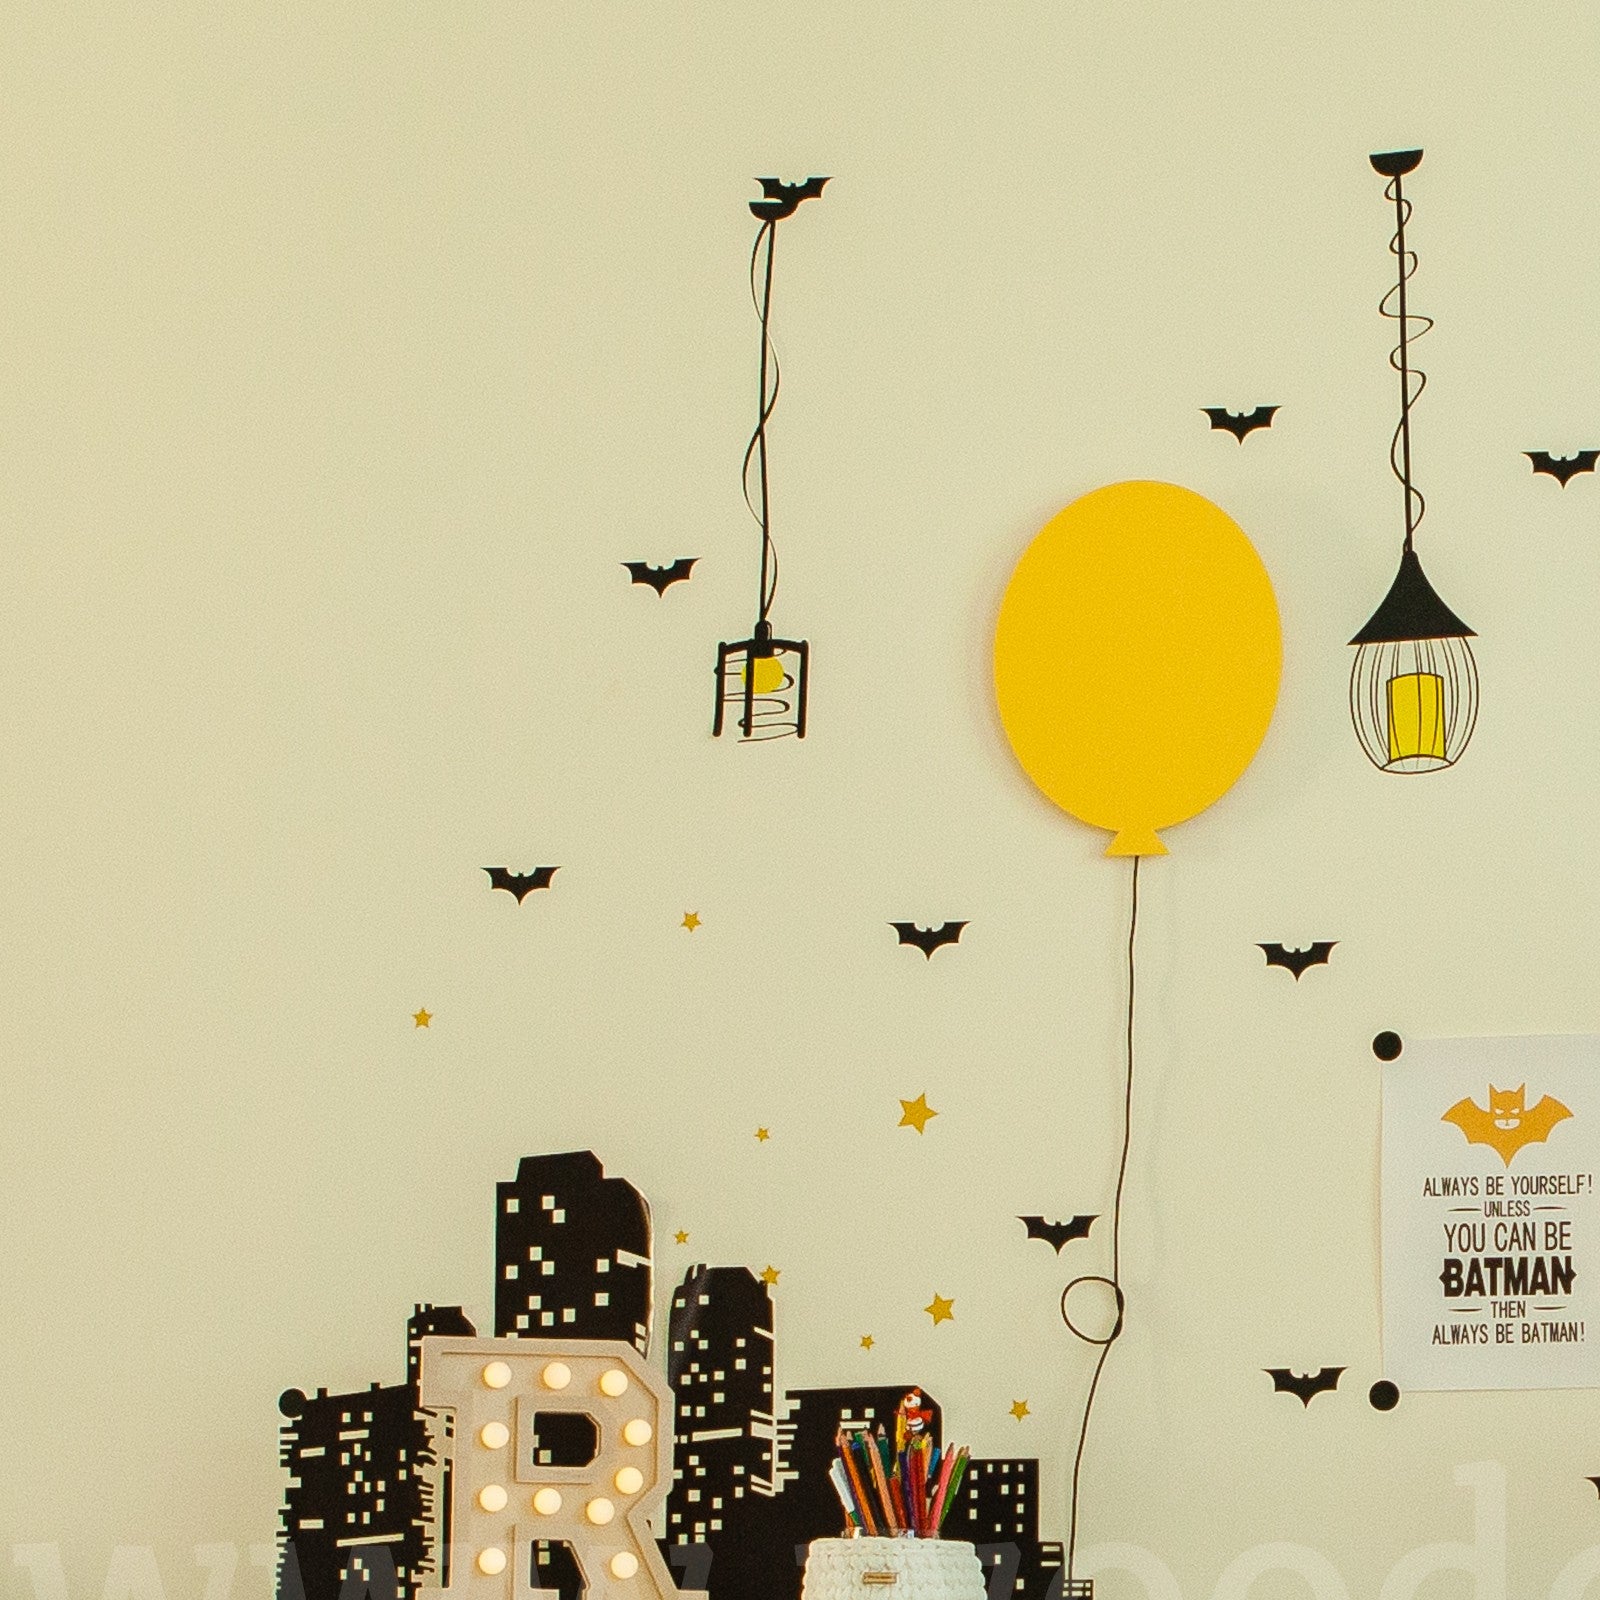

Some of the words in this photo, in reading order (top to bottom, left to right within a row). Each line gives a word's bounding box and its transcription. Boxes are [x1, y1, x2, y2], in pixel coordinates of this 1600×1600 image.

[1423, 1176, 1479, 1197] ALWAYS
[1485, 1176, 1505, 1196] BE
[1511, 1174, 1593, 1195] YOURSELF!
[1483, 1200, 1531, 1217] UNLESS
[1443, 1223, 1486, 1252] YOU
[1494, 1222, 1536, 1252] CAN
[1544, 1221, 1572, 1251] BE
[1439, 1256, 1577, 1298] BATMAN
[1490, 1301, 1527, 1319] THEN
[1432, 1324, 1489, 1345] ALWAYS
[1495, 1323, 1515, 1344] BE
[1521, 1321, 1586, 1344] BATMAN!
